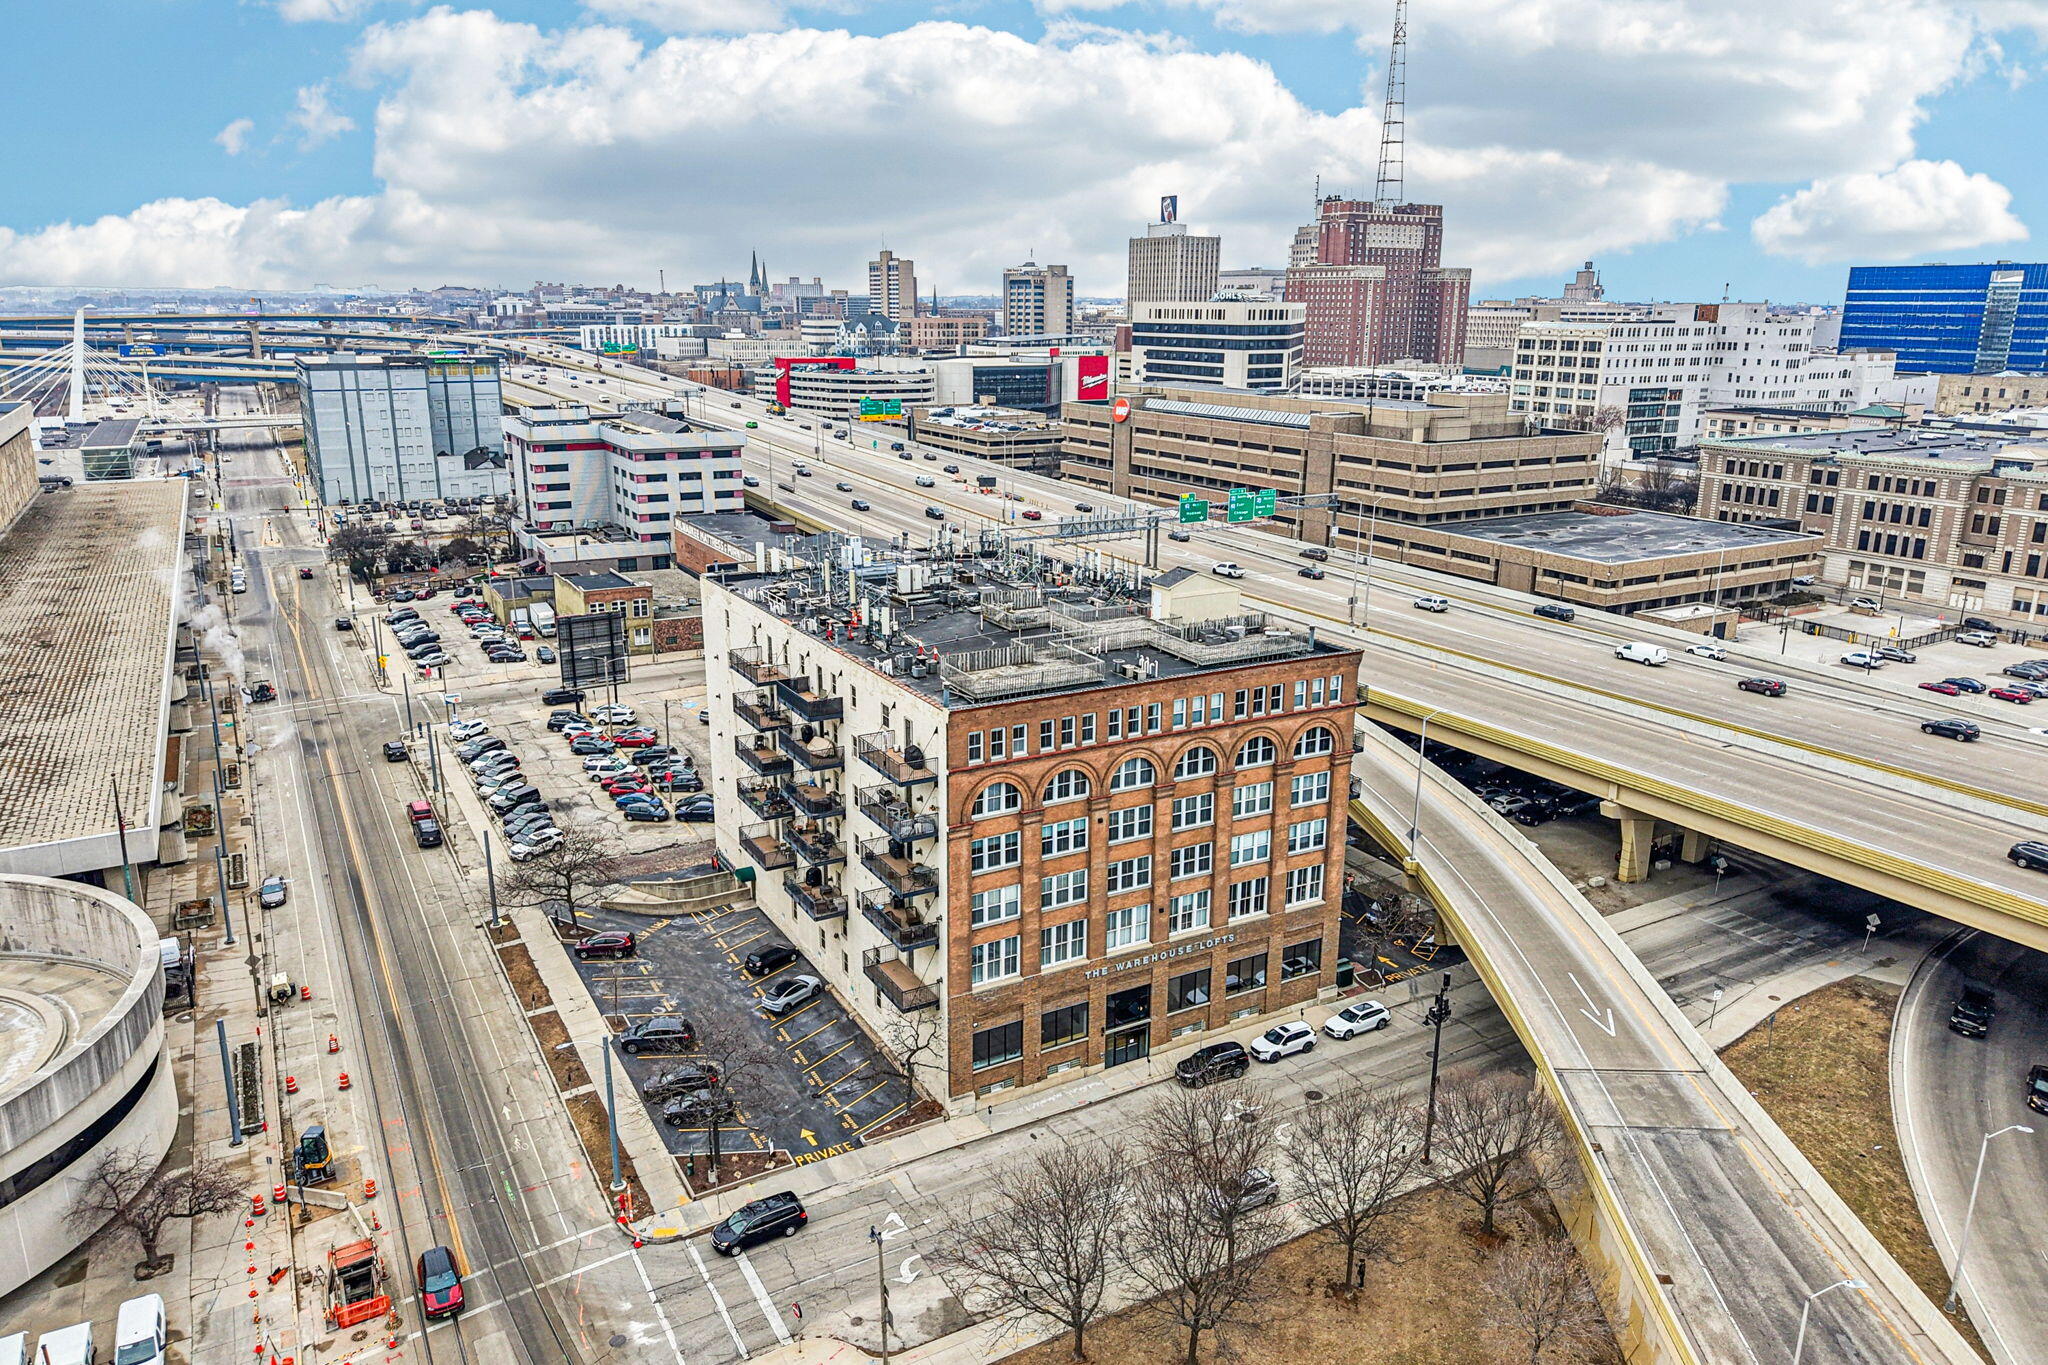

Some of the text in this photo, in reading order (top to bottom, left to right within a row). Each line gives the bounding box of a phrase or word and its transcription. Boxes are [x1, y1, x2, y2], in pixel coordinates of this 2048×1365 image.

[1084, 933, 1235, 980] THE WAREHOUSE LOFTS
[1384, 963, 1434, 983] PRIVATE
[794, 1141, 855, 1167] PRIVATE
